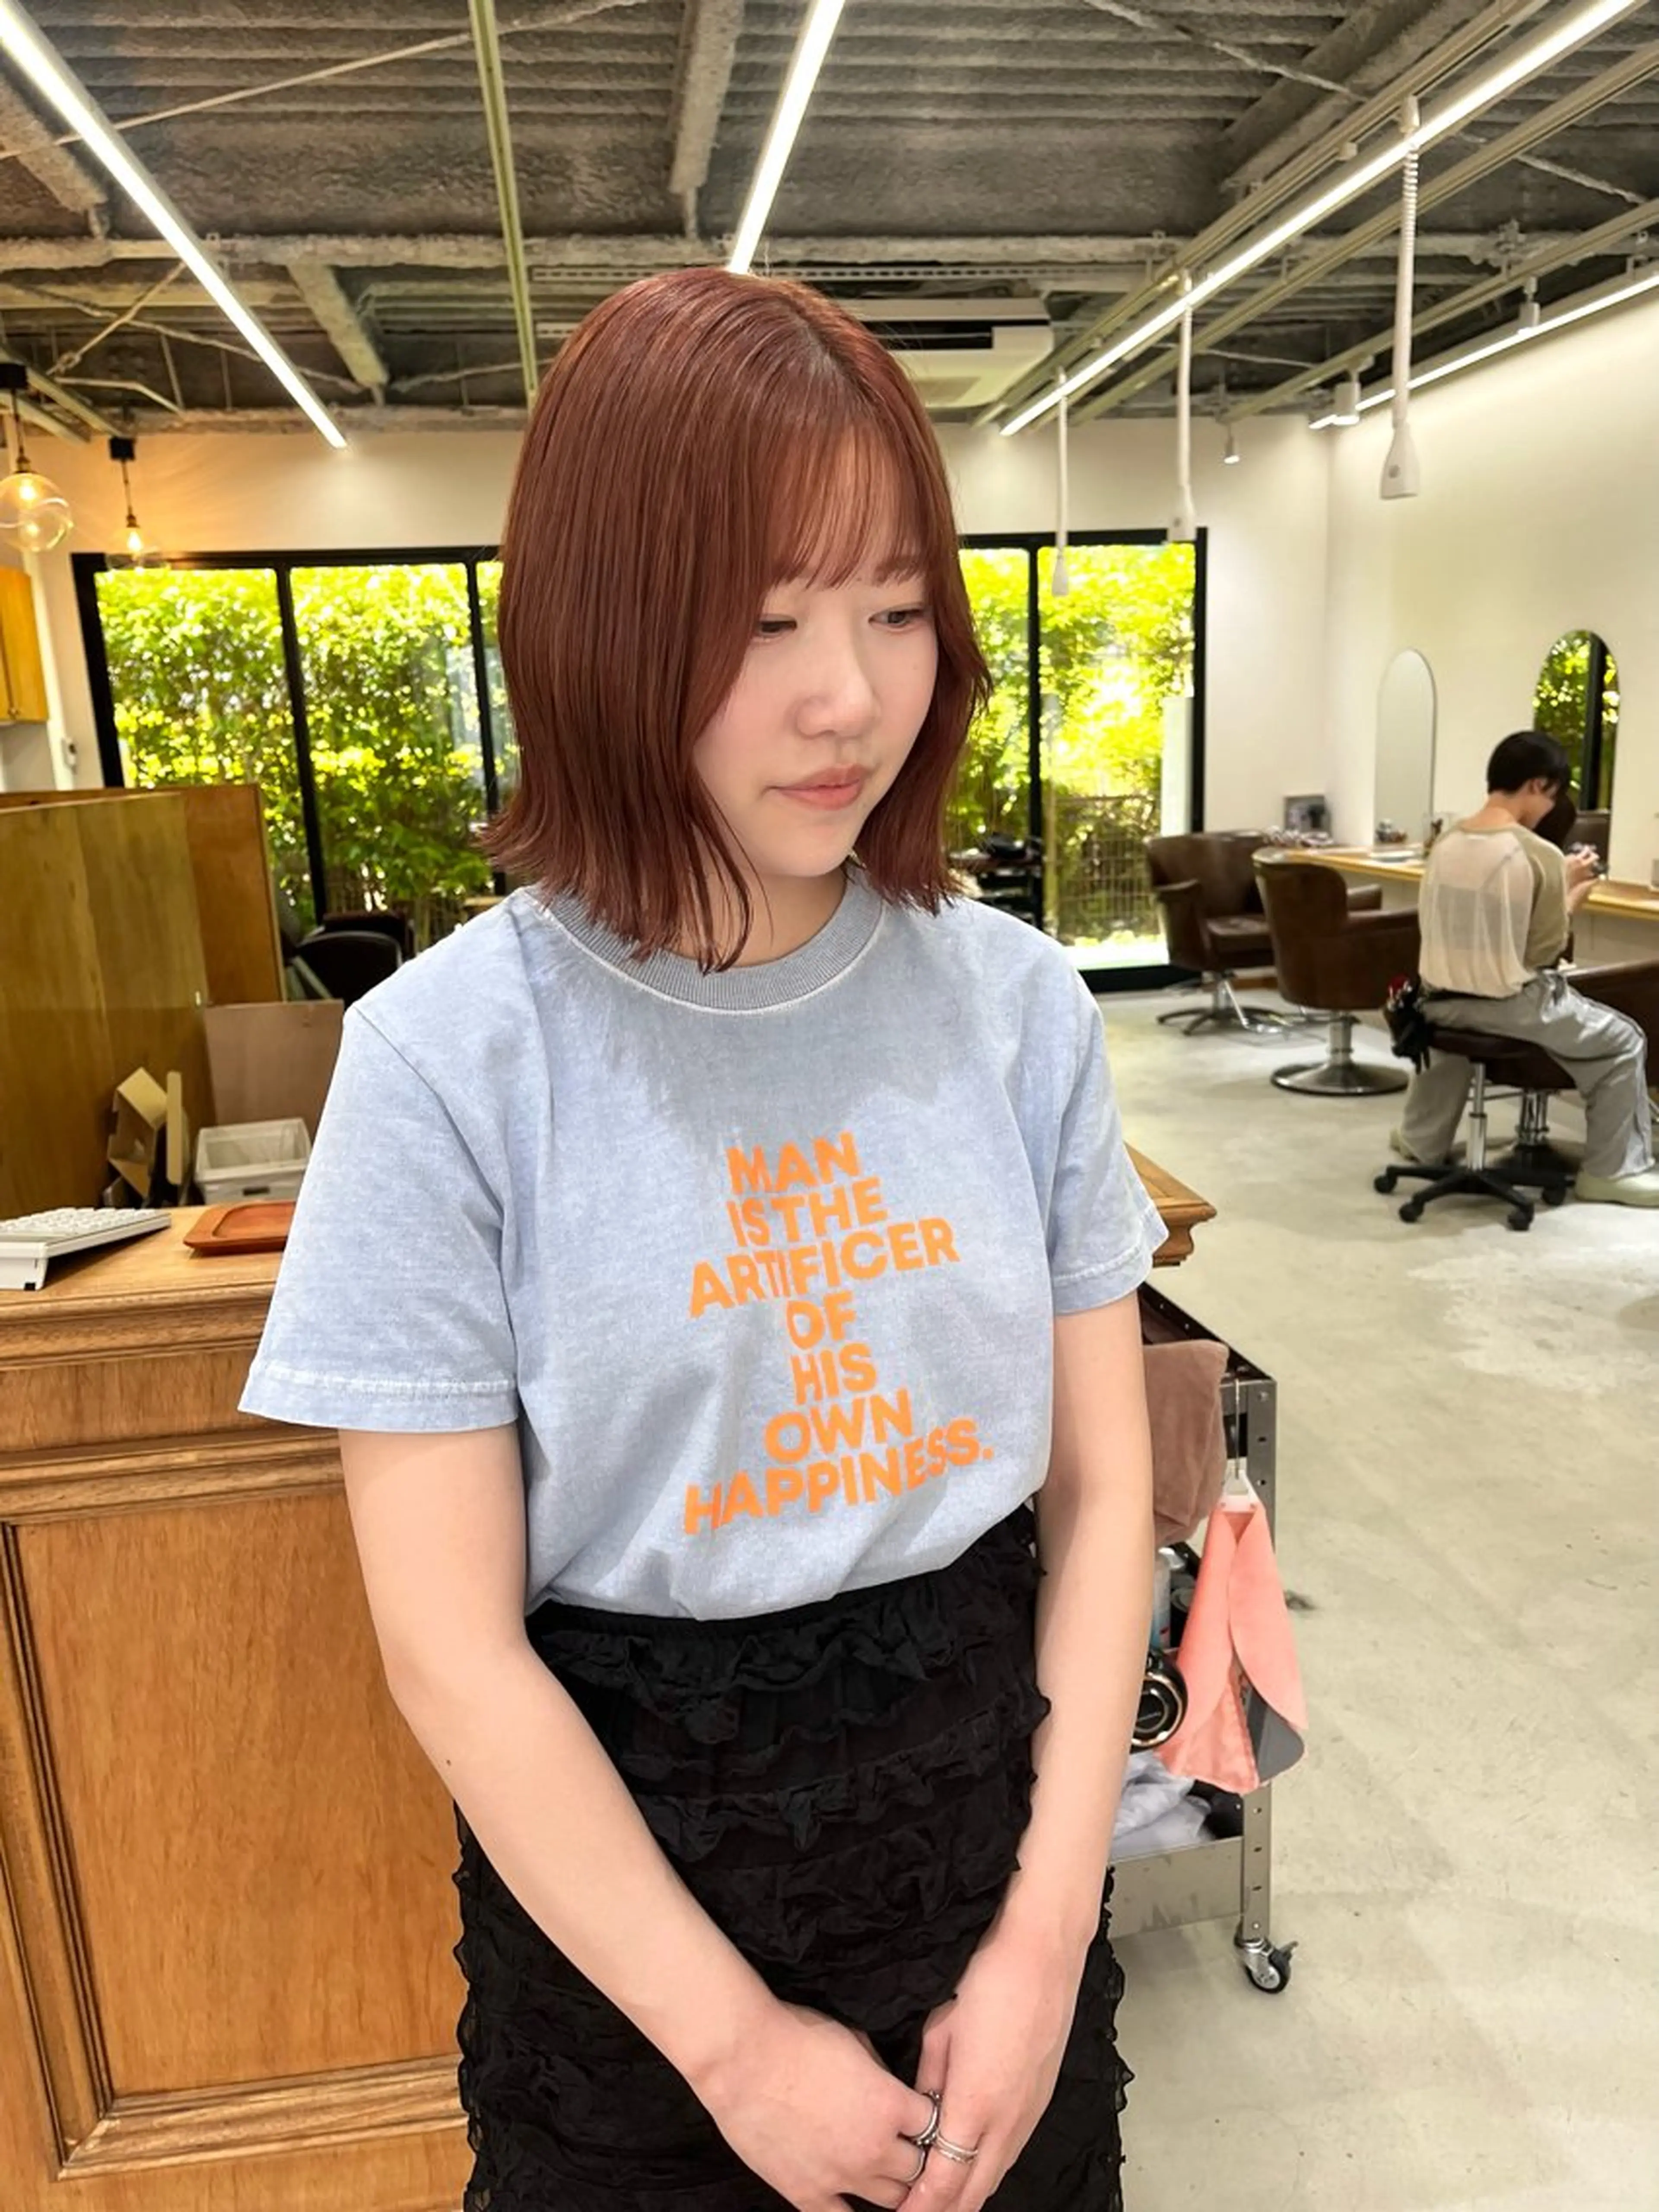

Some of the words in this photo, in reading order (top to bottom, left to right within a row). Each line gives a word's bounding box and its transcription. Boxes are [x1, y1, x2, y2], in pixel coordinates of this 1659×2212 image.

[727, 1131, 861, 1195] MAN
[727, 1197, 771, 1247] IS
[771, 1176, 888, 1243] THE
[689, 1217, 960, 1318] ARTIFICER
[785, 1290, 856, 1350] OF
[790, 1342, 877, 1406] HIS
[764, 1387, 913, 1464] OWN
[684, 1418, 994, 1535] HAPPINESS.
